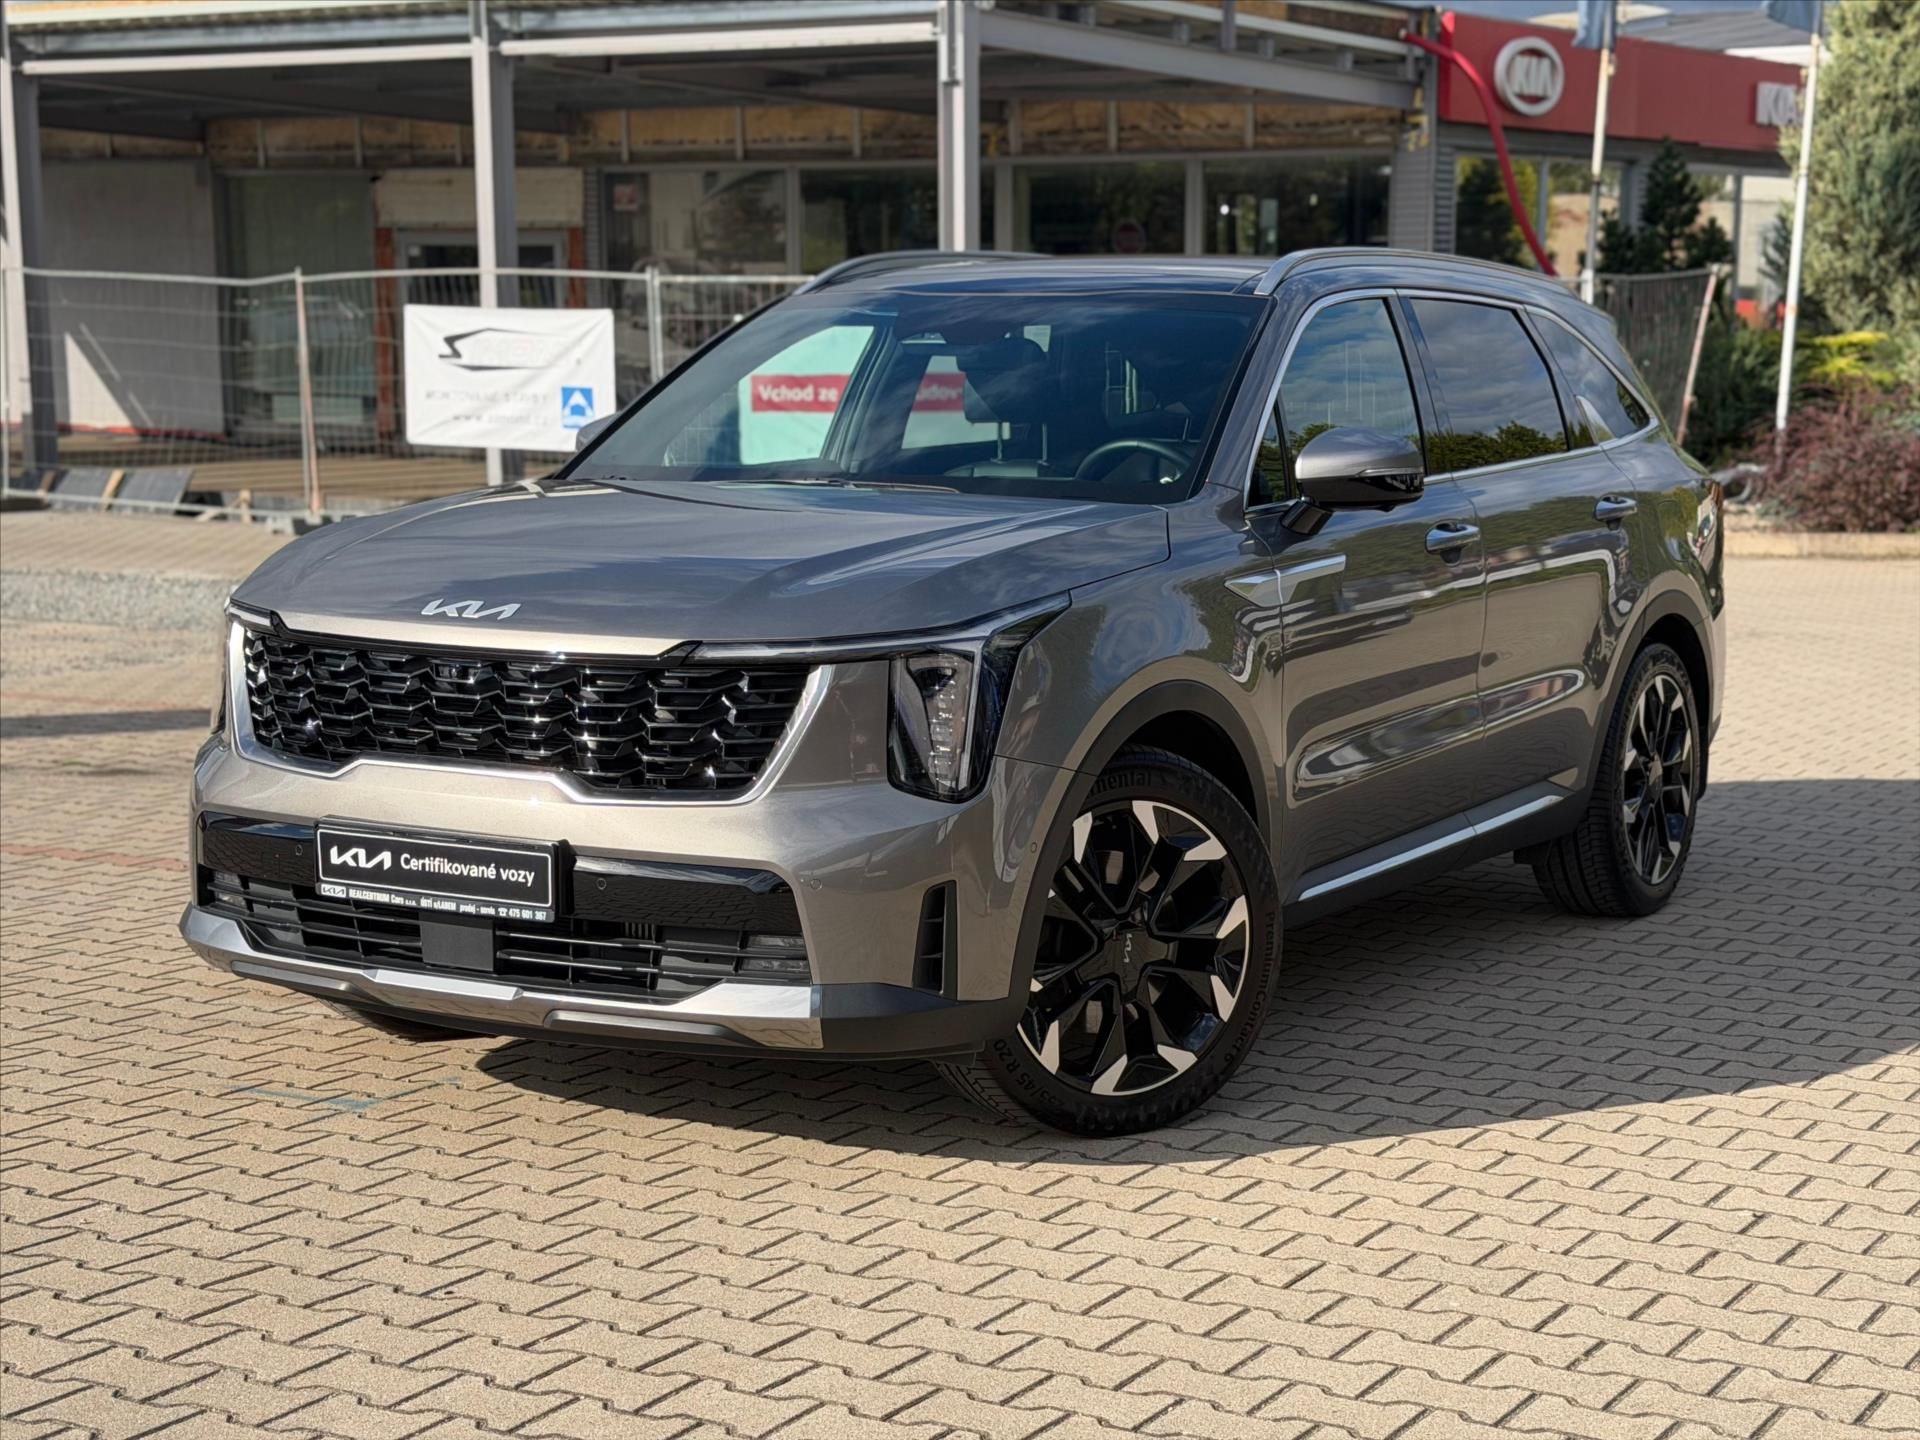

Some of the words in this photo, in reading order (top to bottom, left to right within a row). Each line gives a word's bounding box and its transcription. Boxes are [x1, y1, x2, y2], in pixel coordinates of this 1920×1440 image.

[1511, 54, 1553, 97] KIA
[758, 384, 814, 402] Vchod
[818, 388, 838, 402] ze
[421, 599, 521, 620] KIA
[329, 845, 392, 871] KIA
[400, 853, 497, 879] Certifikované
[500, 868, 535, 887] vozy
[322, 886, 346, 897] KIA
